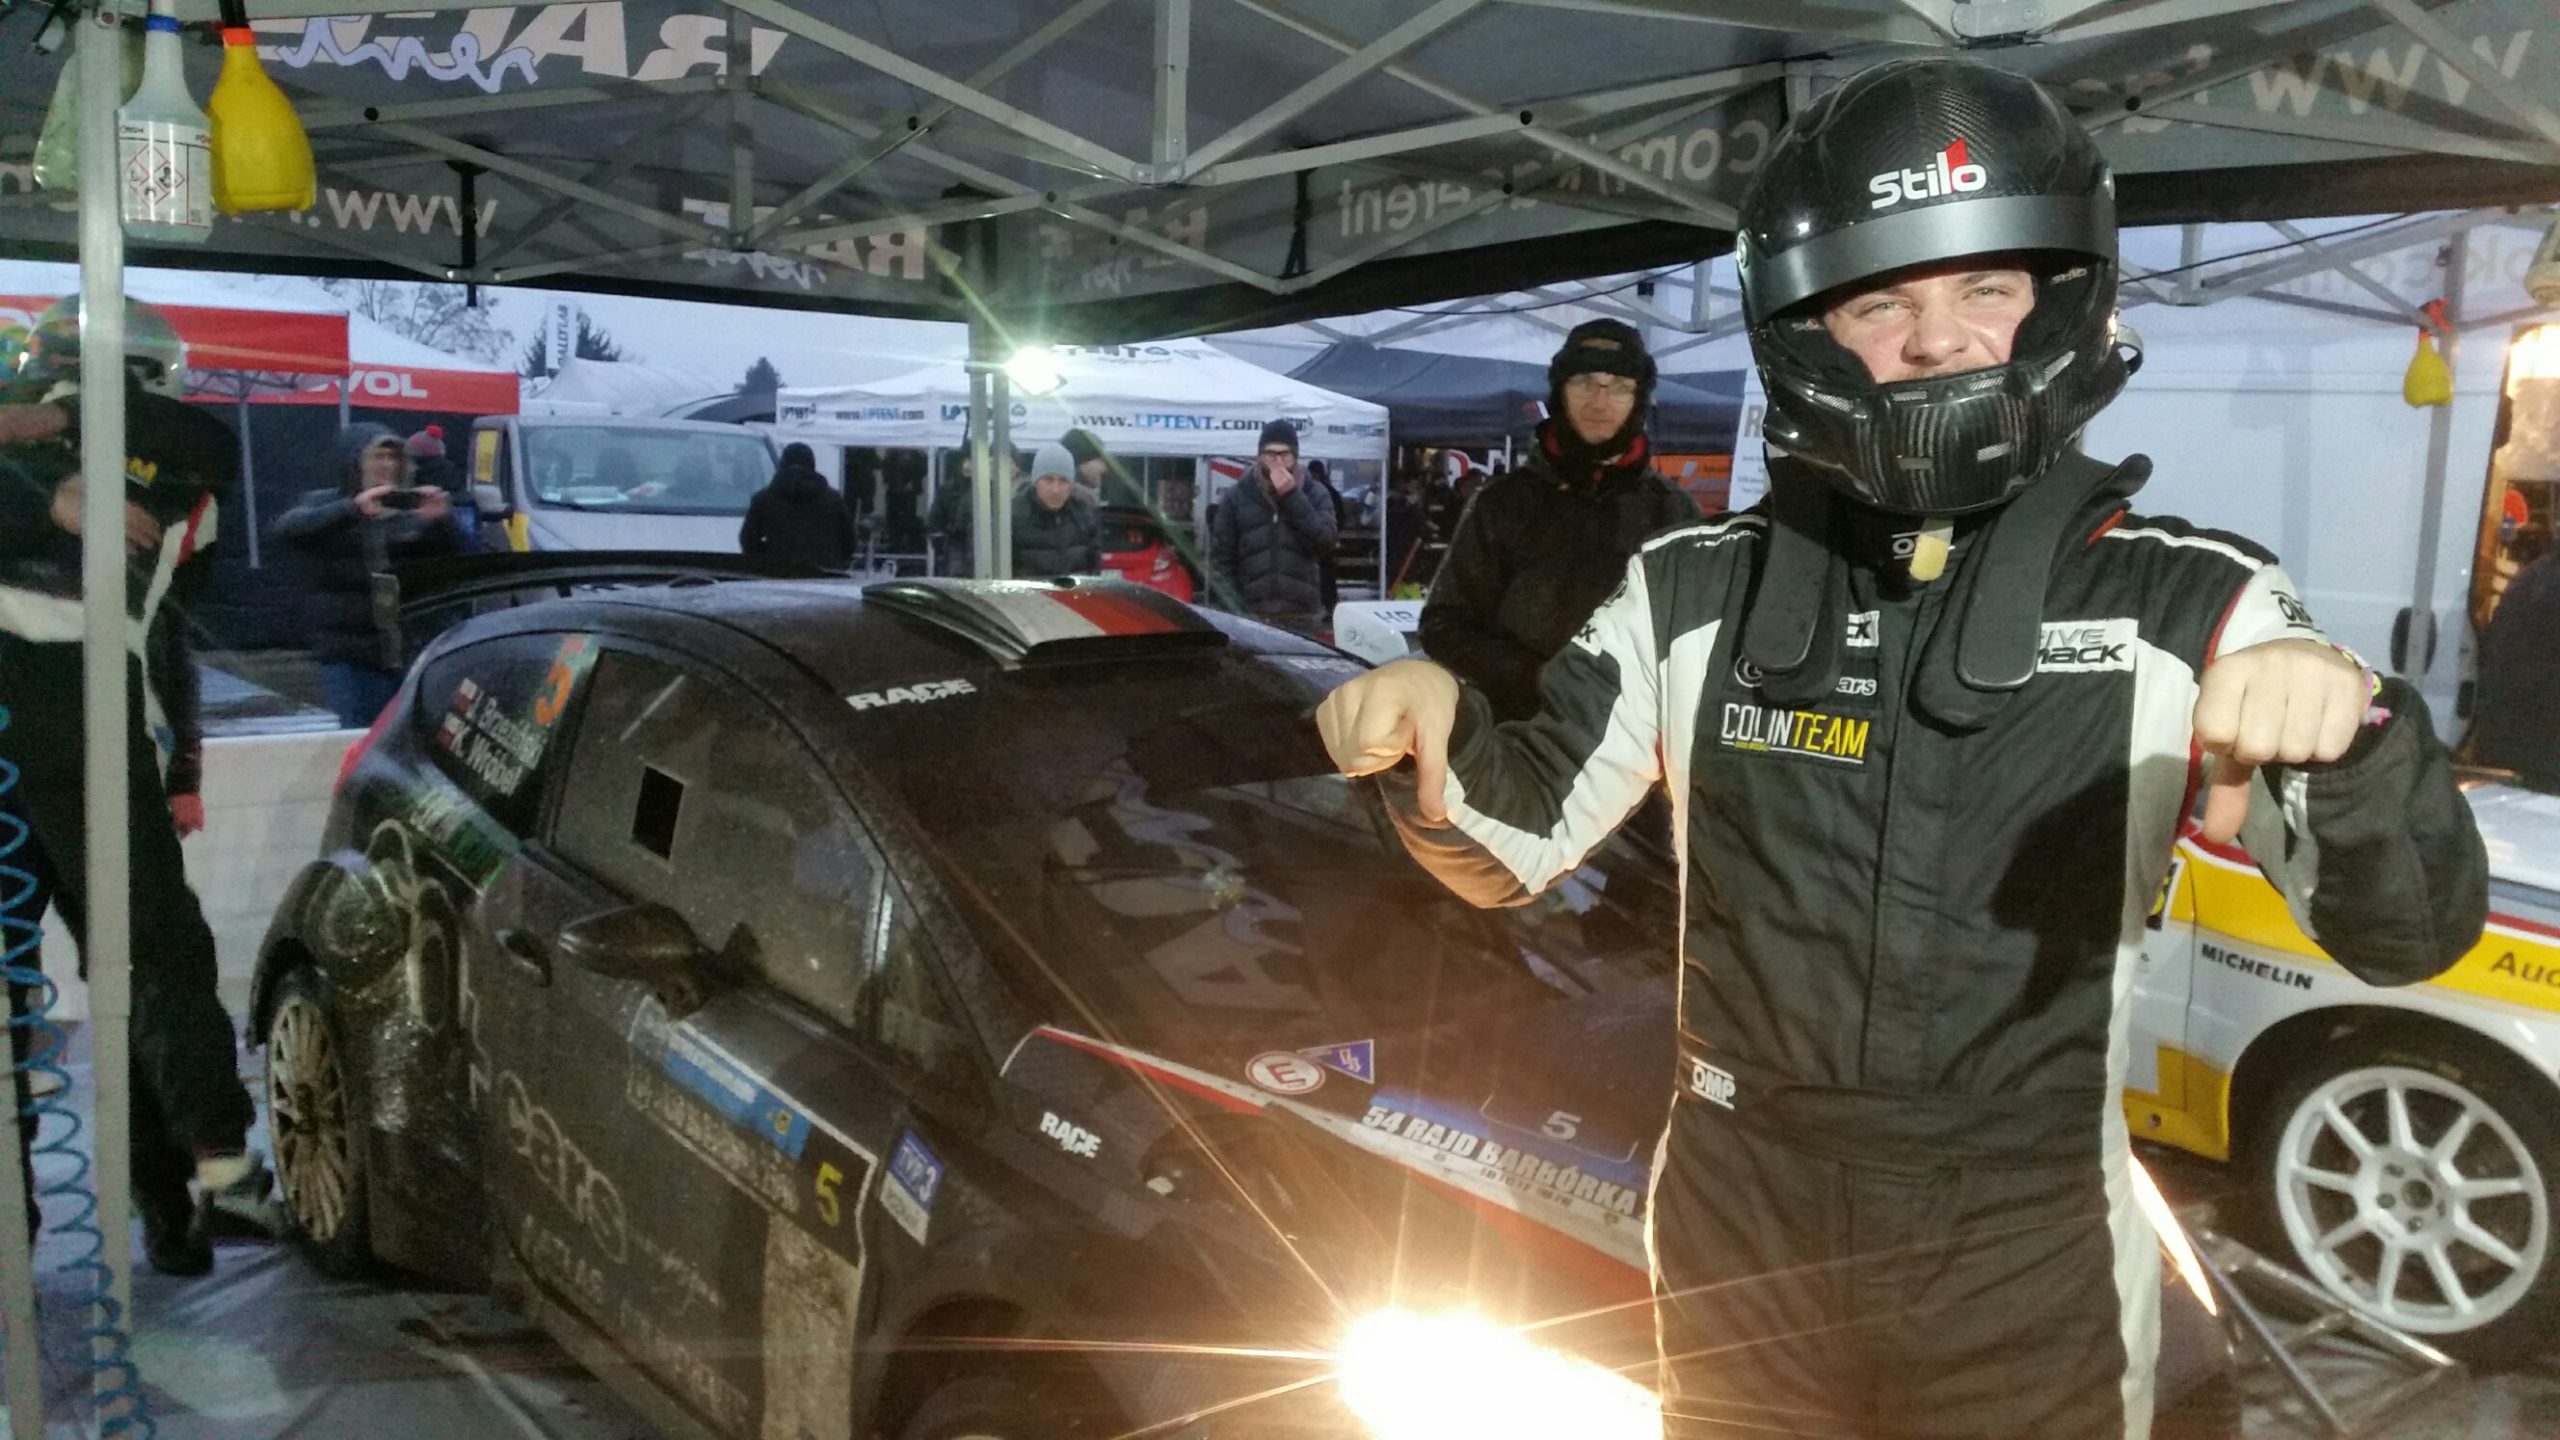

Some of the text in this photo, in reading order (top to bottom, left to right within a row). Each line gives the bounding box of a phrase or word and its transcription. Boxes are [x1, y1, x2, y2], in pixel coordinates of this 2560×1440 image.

[1869, 138, 1987, 210] Stilo
[2040, 628, 2106, 646] IVE
[2201, 943, 2314, 991] MICHELIN
[1692, 1063, 1737, 1102] OMP
[1541, 1110, 1583, 1140] 5
[1361, 1105, 1405, 1134] 54
[1403, 1116, 1479, 1158] RAJD
[1476, 1140, 1638, 1215] BARBÓRKA
[814, 1160, 844, 1227] 5
